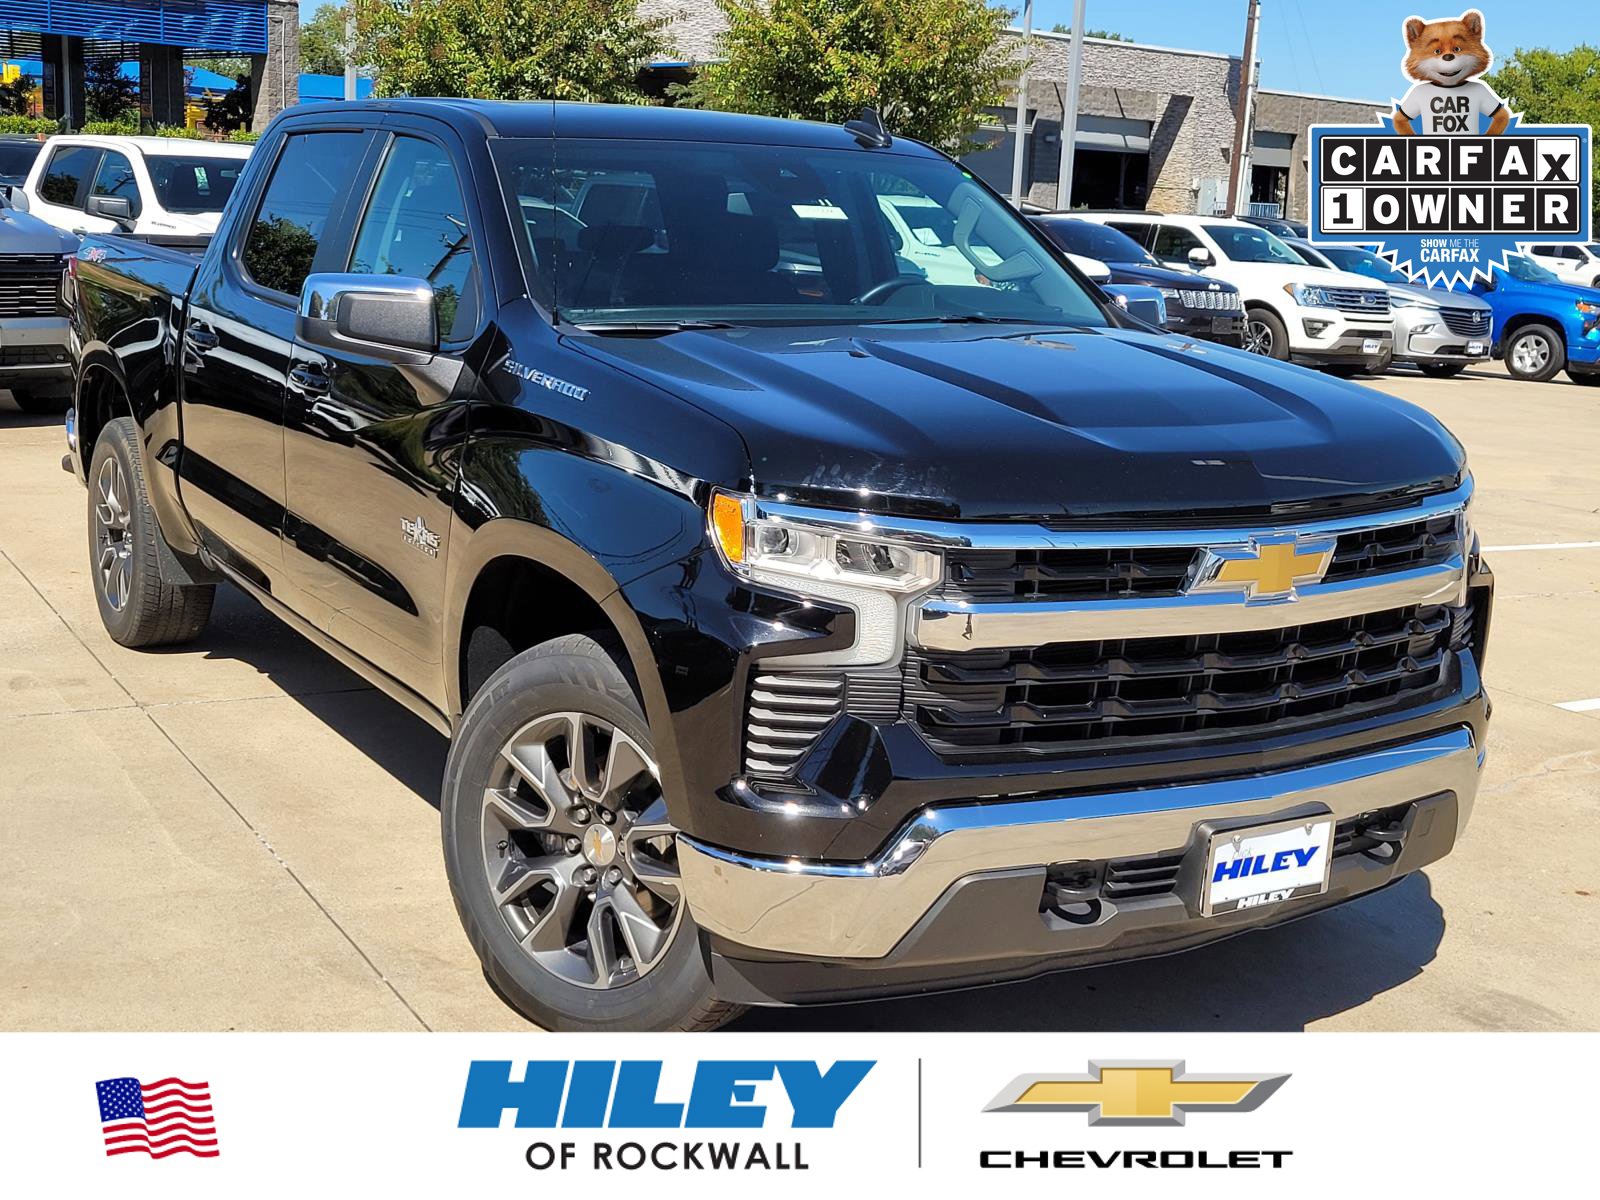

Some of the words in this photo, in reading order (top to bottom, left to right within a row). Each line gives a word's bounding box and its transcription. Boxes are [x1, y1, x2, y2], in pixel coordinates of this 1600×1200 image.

[502, 359, 589, 402] SILVERADO
[1212, 845, 1321, 883] HILEY
[1236, 888, 1295, 909] HILEY
